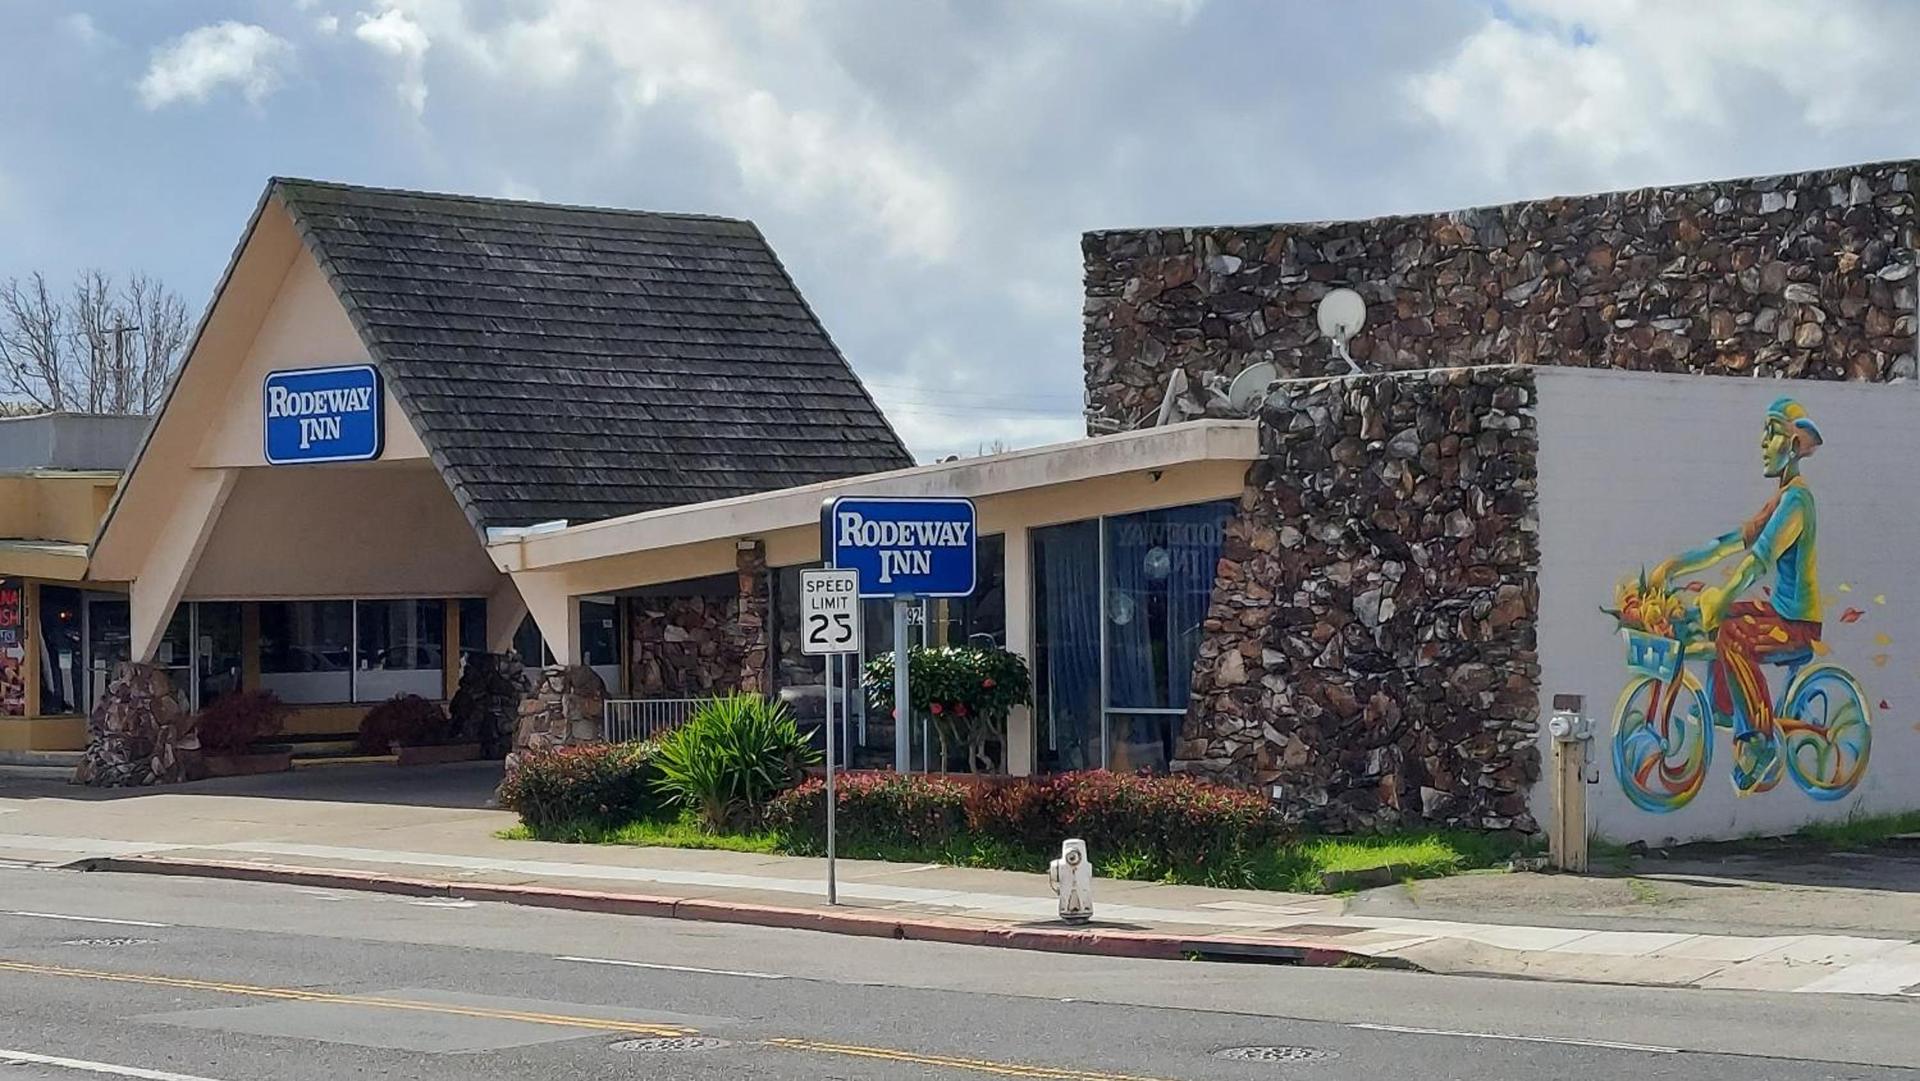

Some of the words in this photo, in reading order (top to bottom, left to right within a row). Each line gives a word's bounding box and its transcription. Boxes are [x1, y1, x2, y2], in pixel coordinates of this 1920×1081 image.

[806, 579, 854, 593] SPEED
[811, 596, 848, 610] LIMIT
[809, 613, 852, 643] 25
